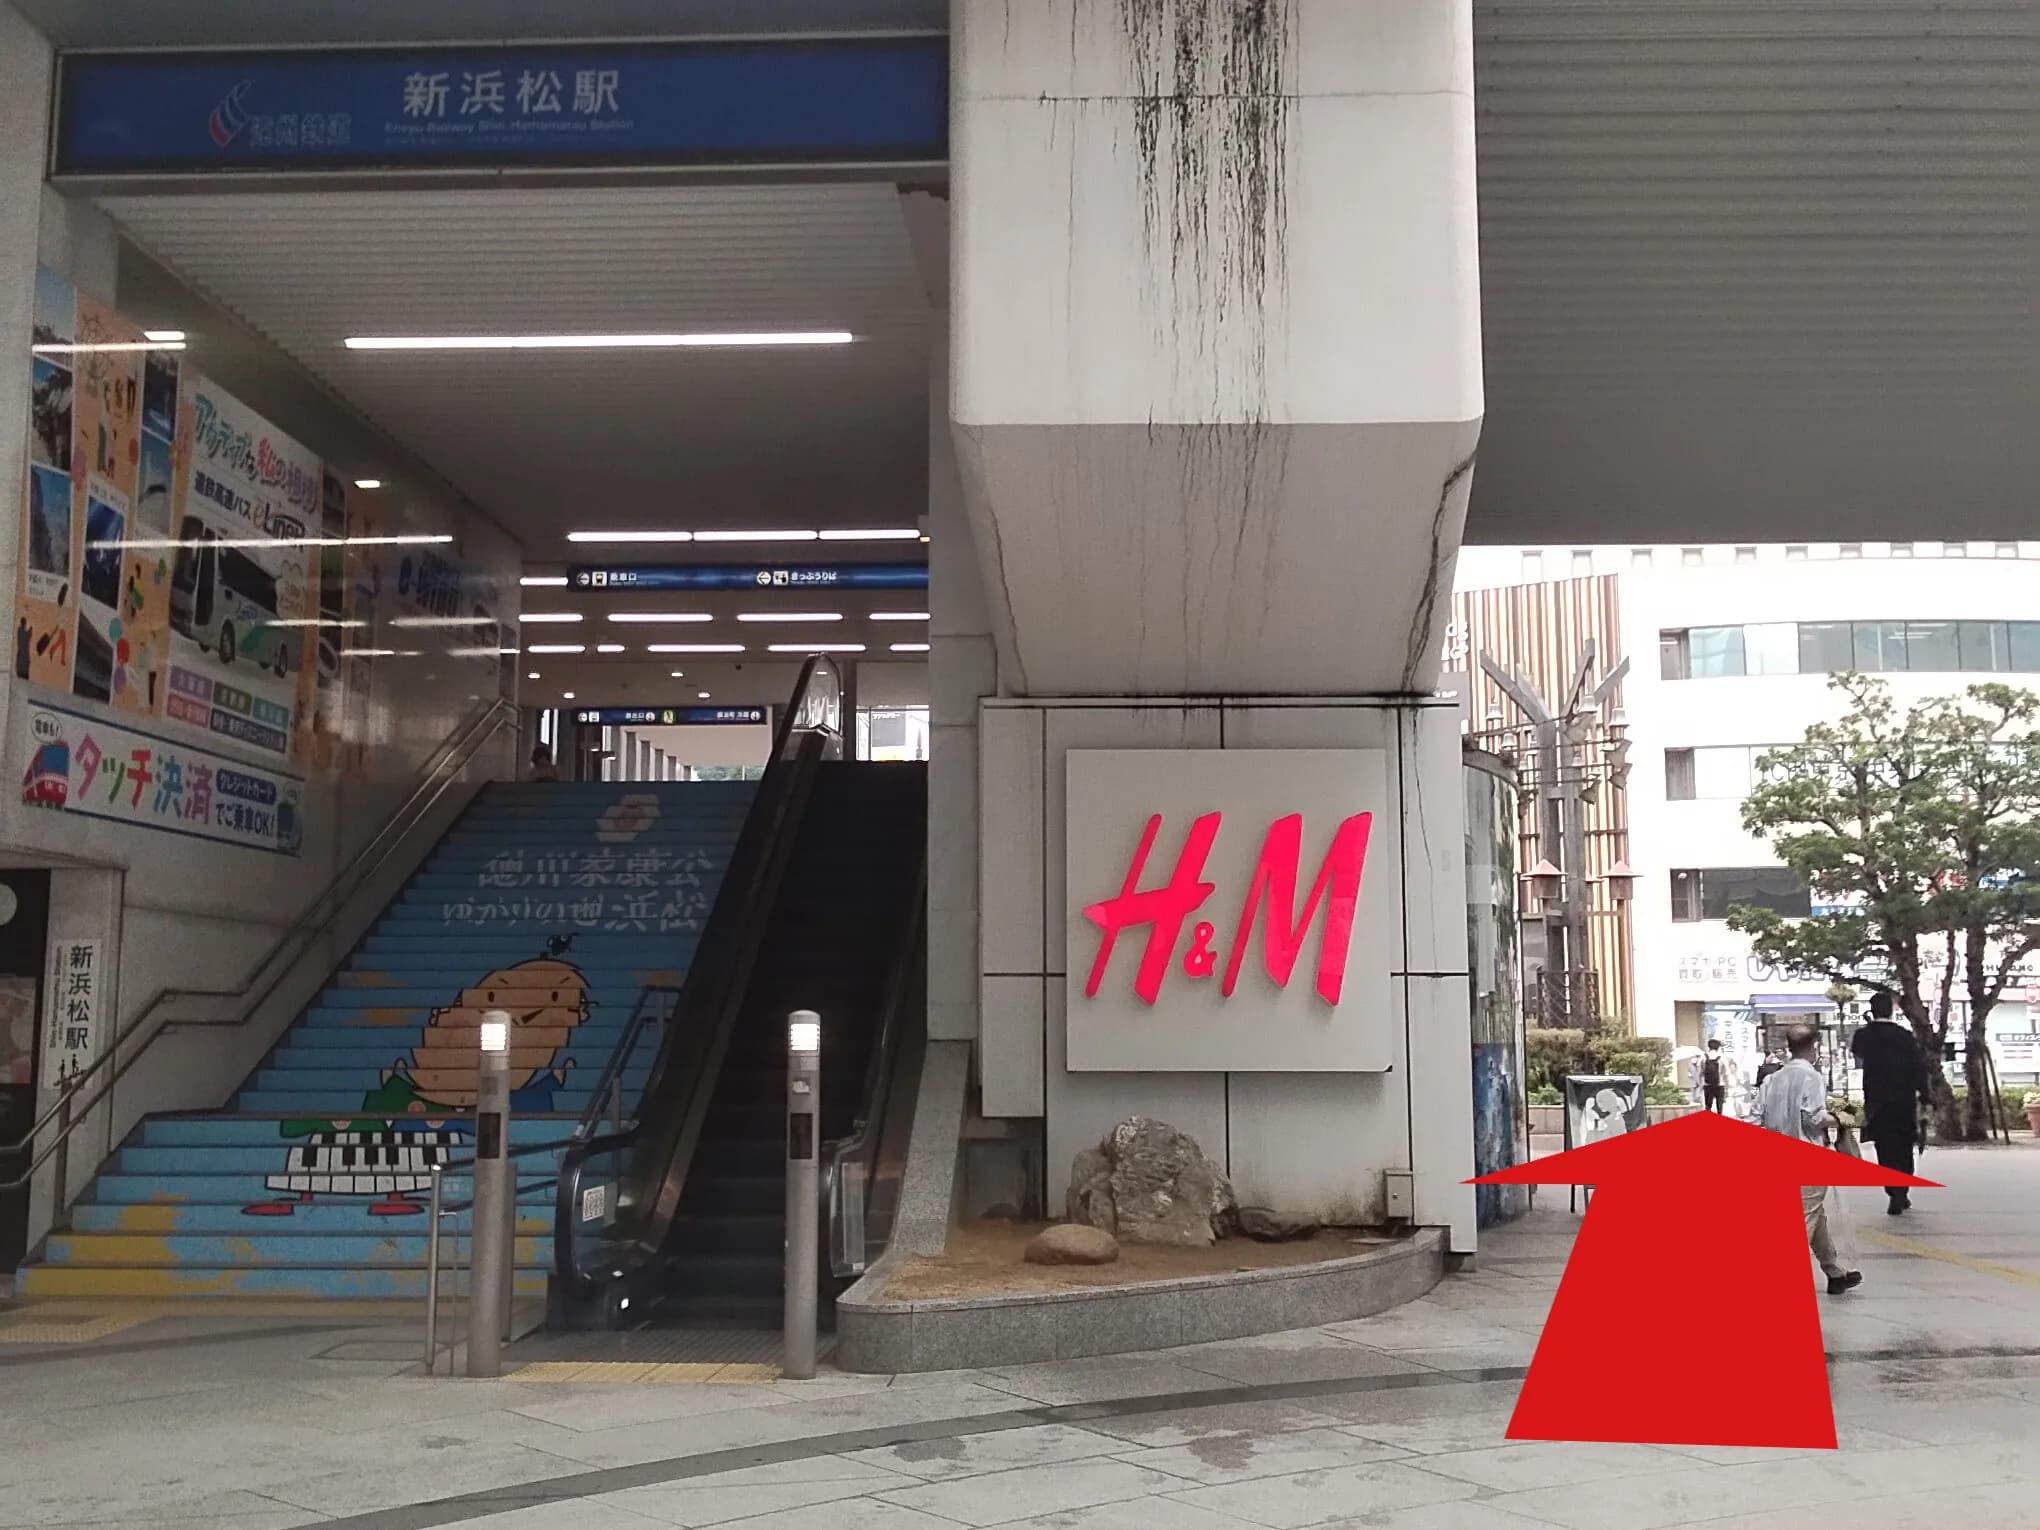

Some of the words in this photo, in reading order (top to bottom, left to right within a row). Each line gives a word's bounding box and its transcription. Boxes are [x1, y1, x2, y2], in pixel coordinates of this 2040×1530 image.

[403, 70, 620, 117] 新浜松駅
[791, 571, 837, 580] きっぷうりば
[75, 733, 213, 825] タッチ決済
[478, 847, 713, 888] 徳川家康公
[1082, 810, 1372, 1007] H&M
[64, 945, 94, 1051] 新浜松駅
